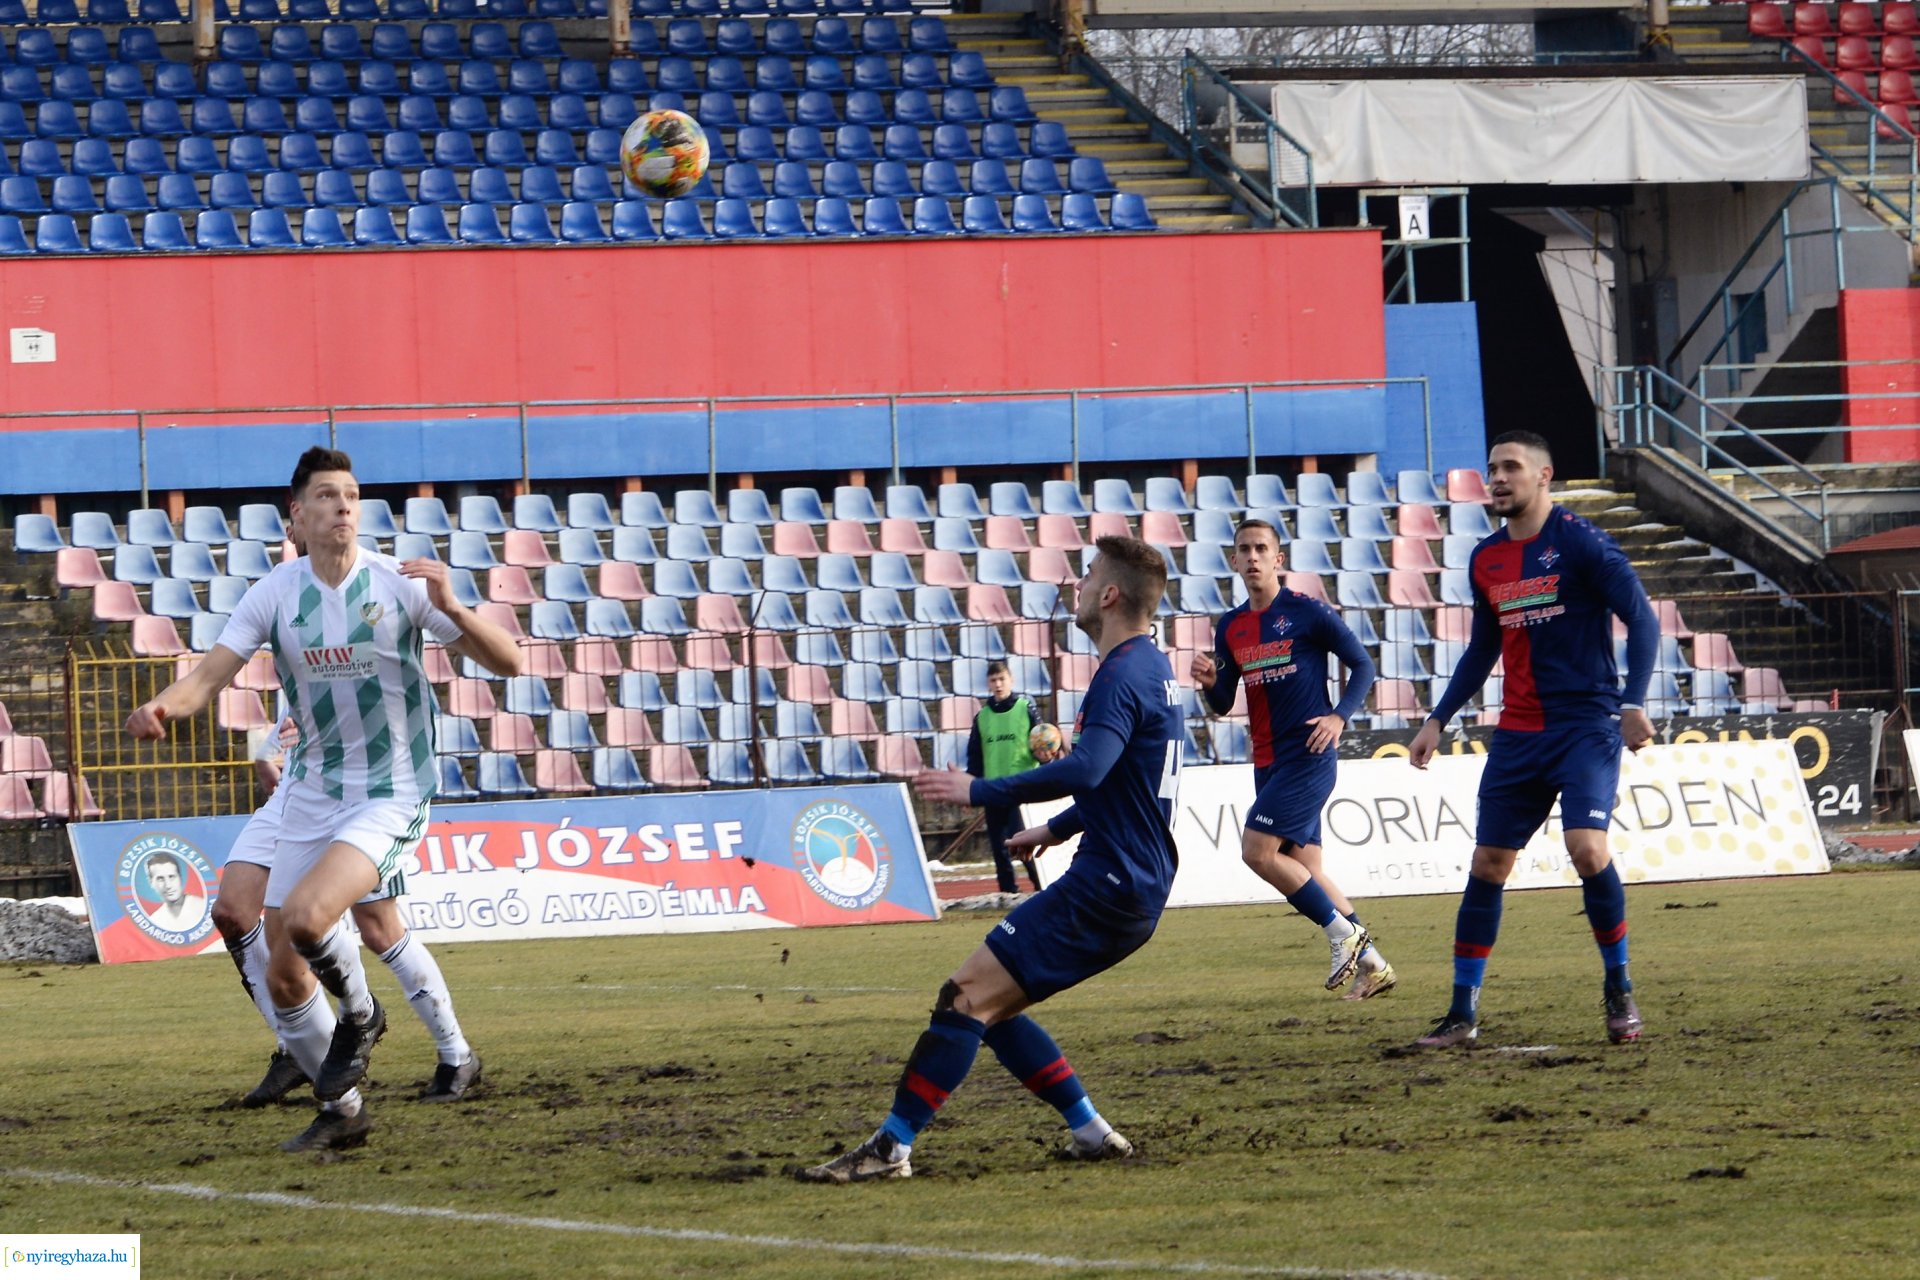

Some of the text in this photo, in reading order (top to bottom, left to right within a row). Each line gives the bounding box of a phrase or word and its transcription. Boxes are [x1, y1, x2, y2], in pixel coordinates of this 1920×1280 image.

[1408, 213, 1422, 235] A
[312, 659, 374, 673] automotive
[1187, 795, 1477, 850] VIORIA
[1255, 814, 1274, 826] JAKO
[120, 837, 157, 878] BOZSIK
[514, 816, 743, 871] JÓZSEF
[1368, 860, 1446, 881] HOTEL
[542, 878, 766, 928] AKADÉMIA
